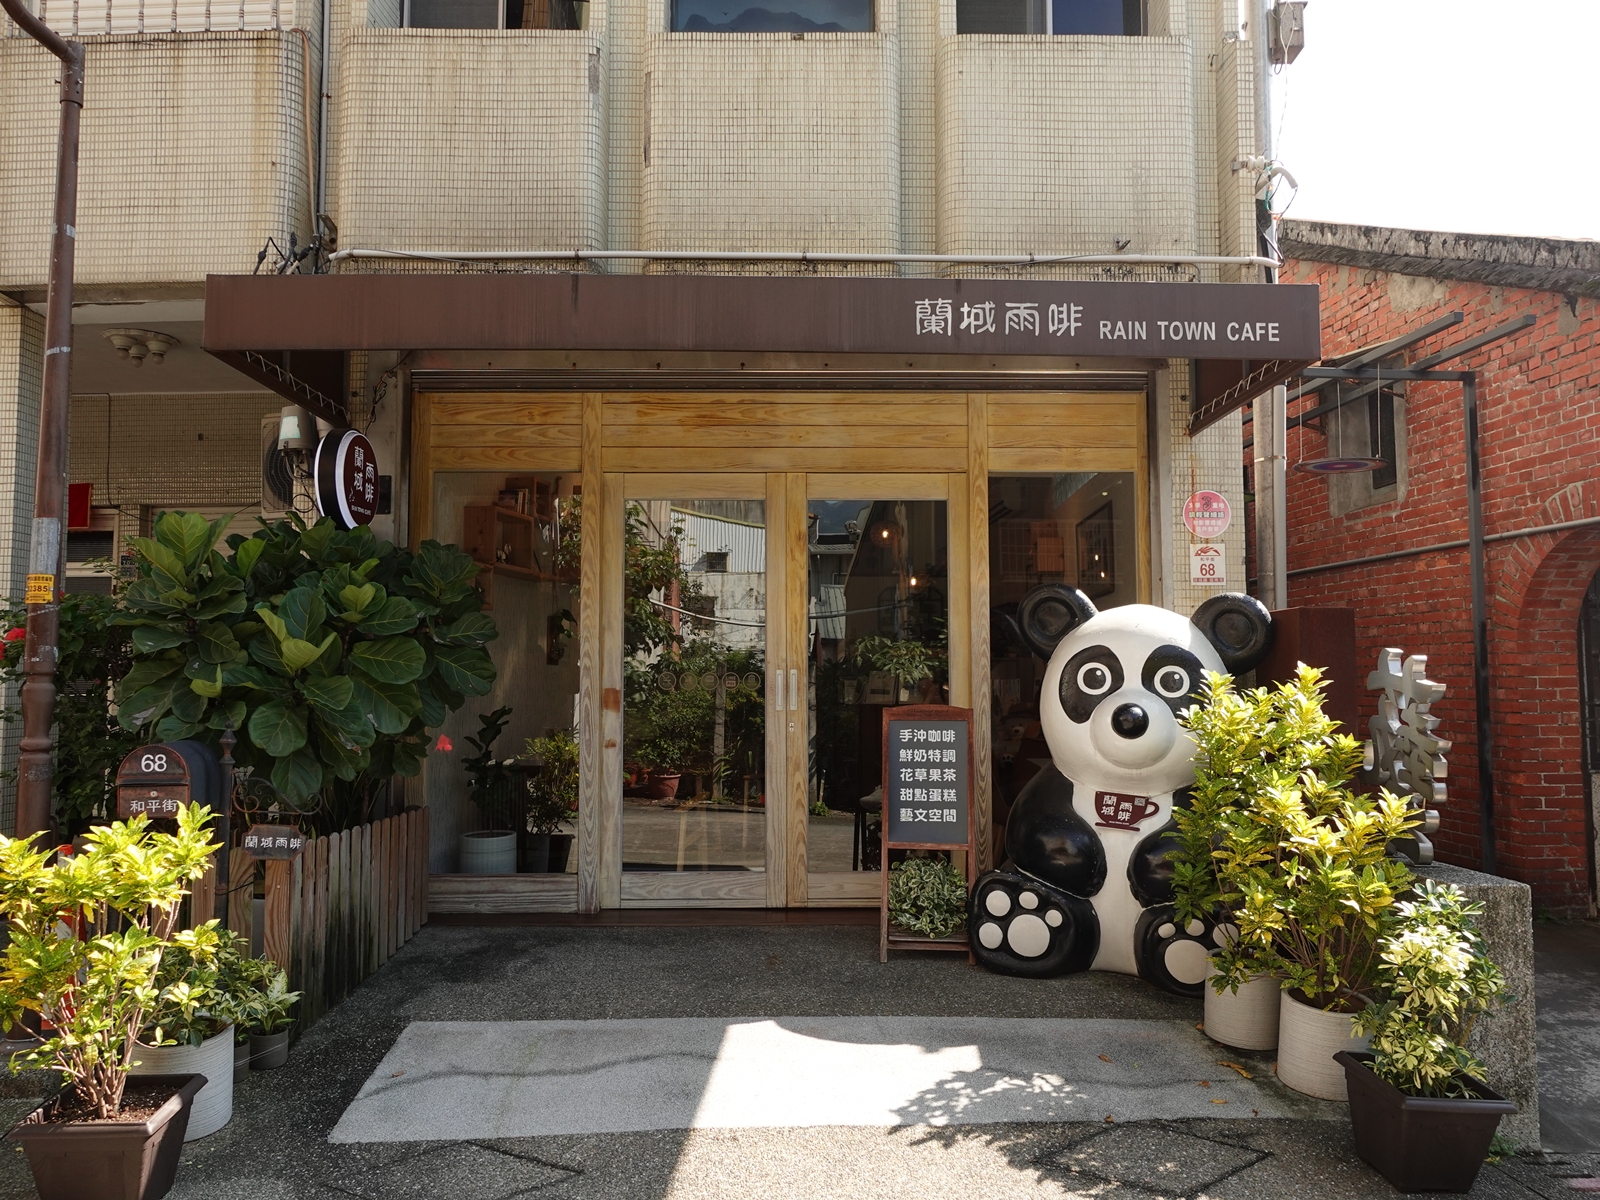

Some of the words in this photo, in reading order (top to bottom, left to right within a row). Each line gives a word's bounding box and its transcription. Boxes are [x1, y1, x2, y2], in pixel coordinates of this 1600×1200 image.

[914, 298, 1083, 337] 蘭城雨啡
[1099, 320, 1147, 341] RAIN
[1157, 320, 1216, 342] TOWN
[1226, 321, 1280, 342] CAFE
[1200, 563, 1215, 576] 68
[899, 729, 956, 742] 手沖咖啡
[141, 754, 167, 772] 68
[899, 749, 956, 763] 鮮奶特調
[899, 768, 957, 782] 花草果茶
[899, 788, 957, 802] 甜點蛋糕
[130, 799, 178, 813] 和平街
[899, 808, 957, 823] 藝文空間
[244, 835, 302, 850] 蘭城雨啡
